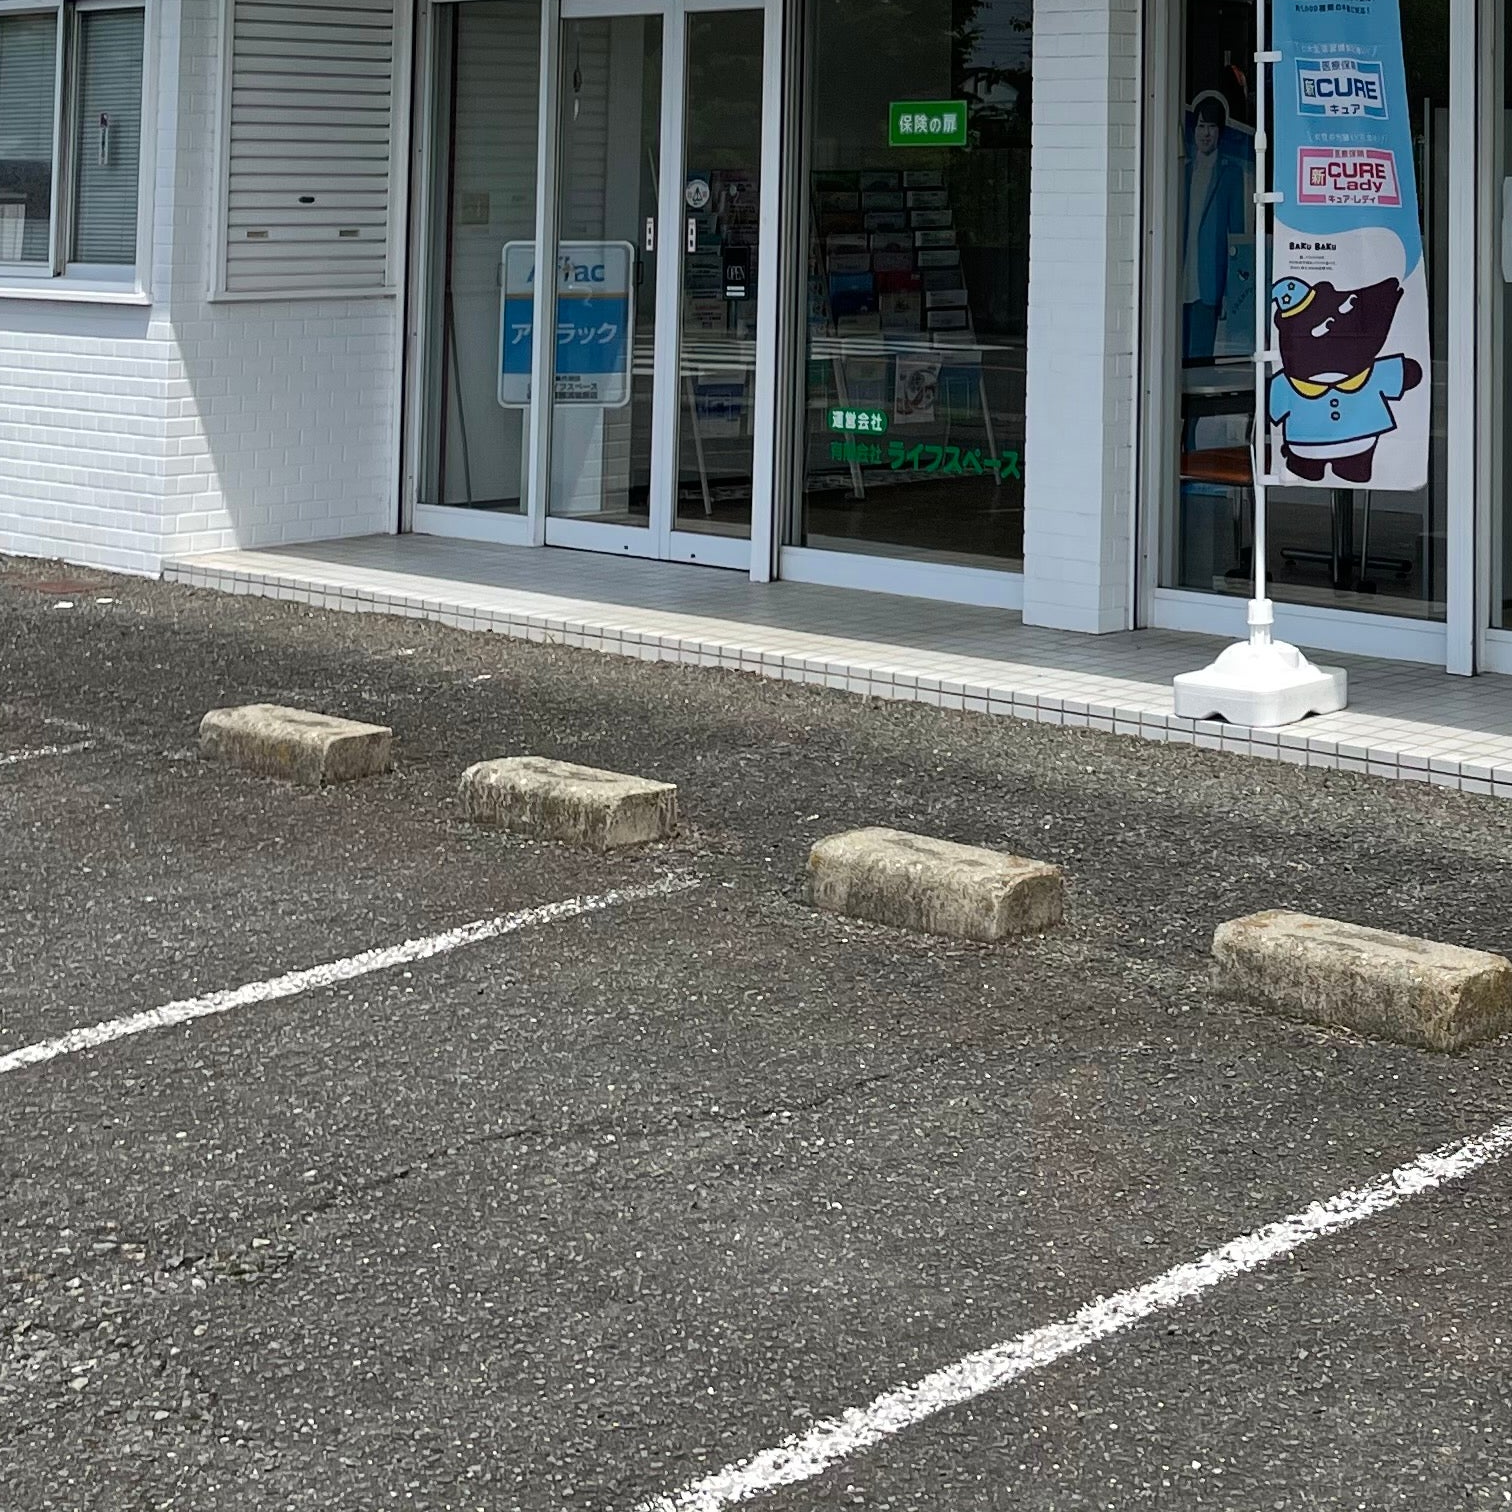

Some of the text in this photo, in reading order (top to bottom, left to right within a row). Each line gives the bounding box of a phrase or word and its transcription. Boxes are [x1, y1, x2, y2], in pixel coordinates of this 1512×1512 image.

[1316, 77, 1378, 100] CURE
[1329, 104, 1360, 114] キュア
[899, 112, 958, 134] 保険の扉
[1328, 162, 1386, 179] CURE
[1334, 179, 1382, 192] Lady
[512, 322, 617, 345] アラック
[832, 411, 883, 431] 運営会社
[887, 441, 1021, 480] ライフスペース
